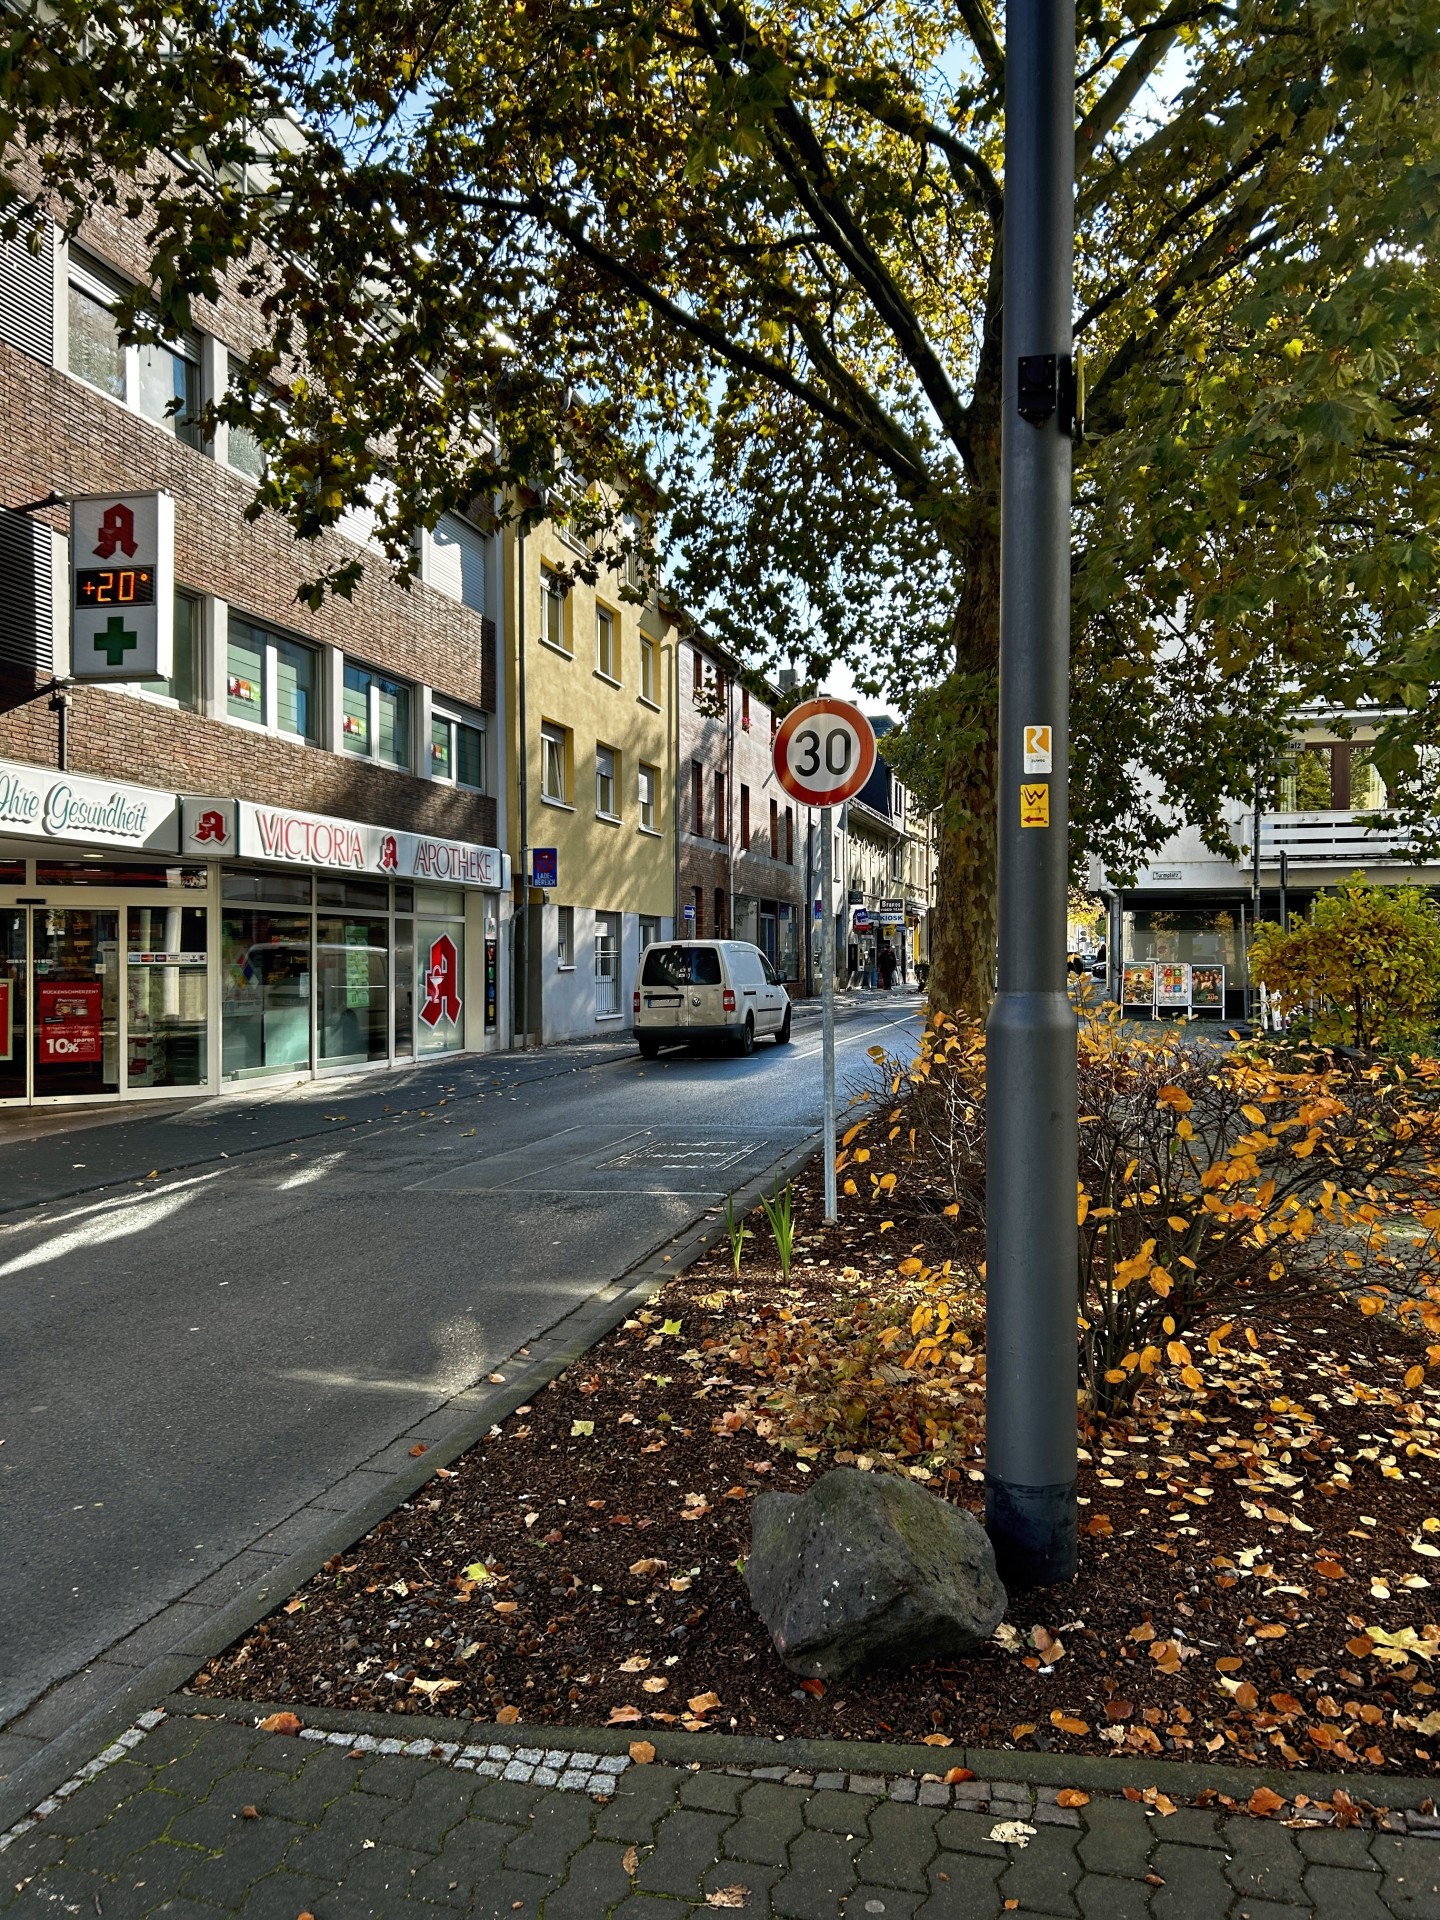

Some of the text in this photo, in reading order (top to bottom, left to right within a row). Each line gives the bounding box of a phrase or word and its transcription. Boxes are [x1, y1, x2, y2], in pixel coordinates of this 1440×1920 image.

[794, 727, 853, 777] 30
[50, 785, 147, 832] Gesundheit
[260, 813, 365, 865] VICTORIA
[415, 841, 492, 880] APOTHEKE
[534, 878, 557, 886] BEREICH
[46, 1038, 79, 1054] 10%
